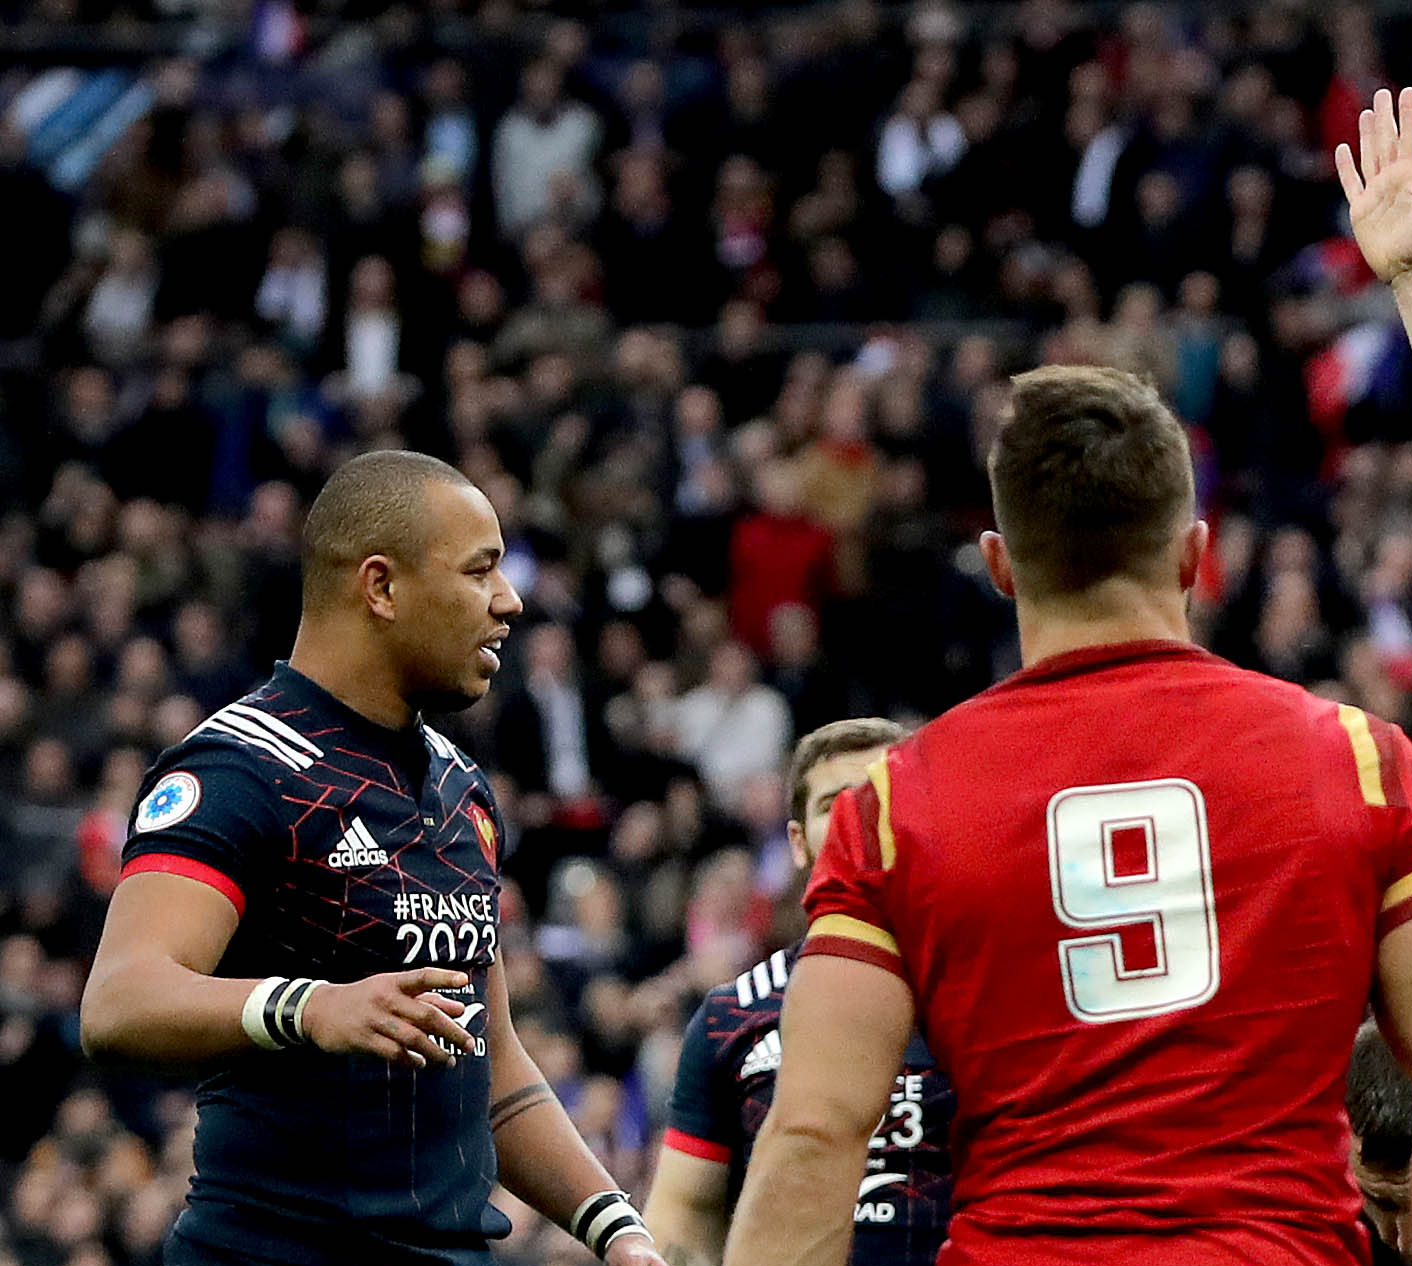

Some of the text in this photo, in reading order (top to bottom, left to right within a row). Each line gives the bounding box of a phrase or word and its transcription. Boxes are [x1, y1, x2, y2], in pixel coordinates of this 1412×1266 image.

[328, 849, 389, 868] adidas
[394, 893, 494, 922] #FRANCE
[1046, 777, 1221, 1024] 9
[396, 922, 497, 965] 2023
